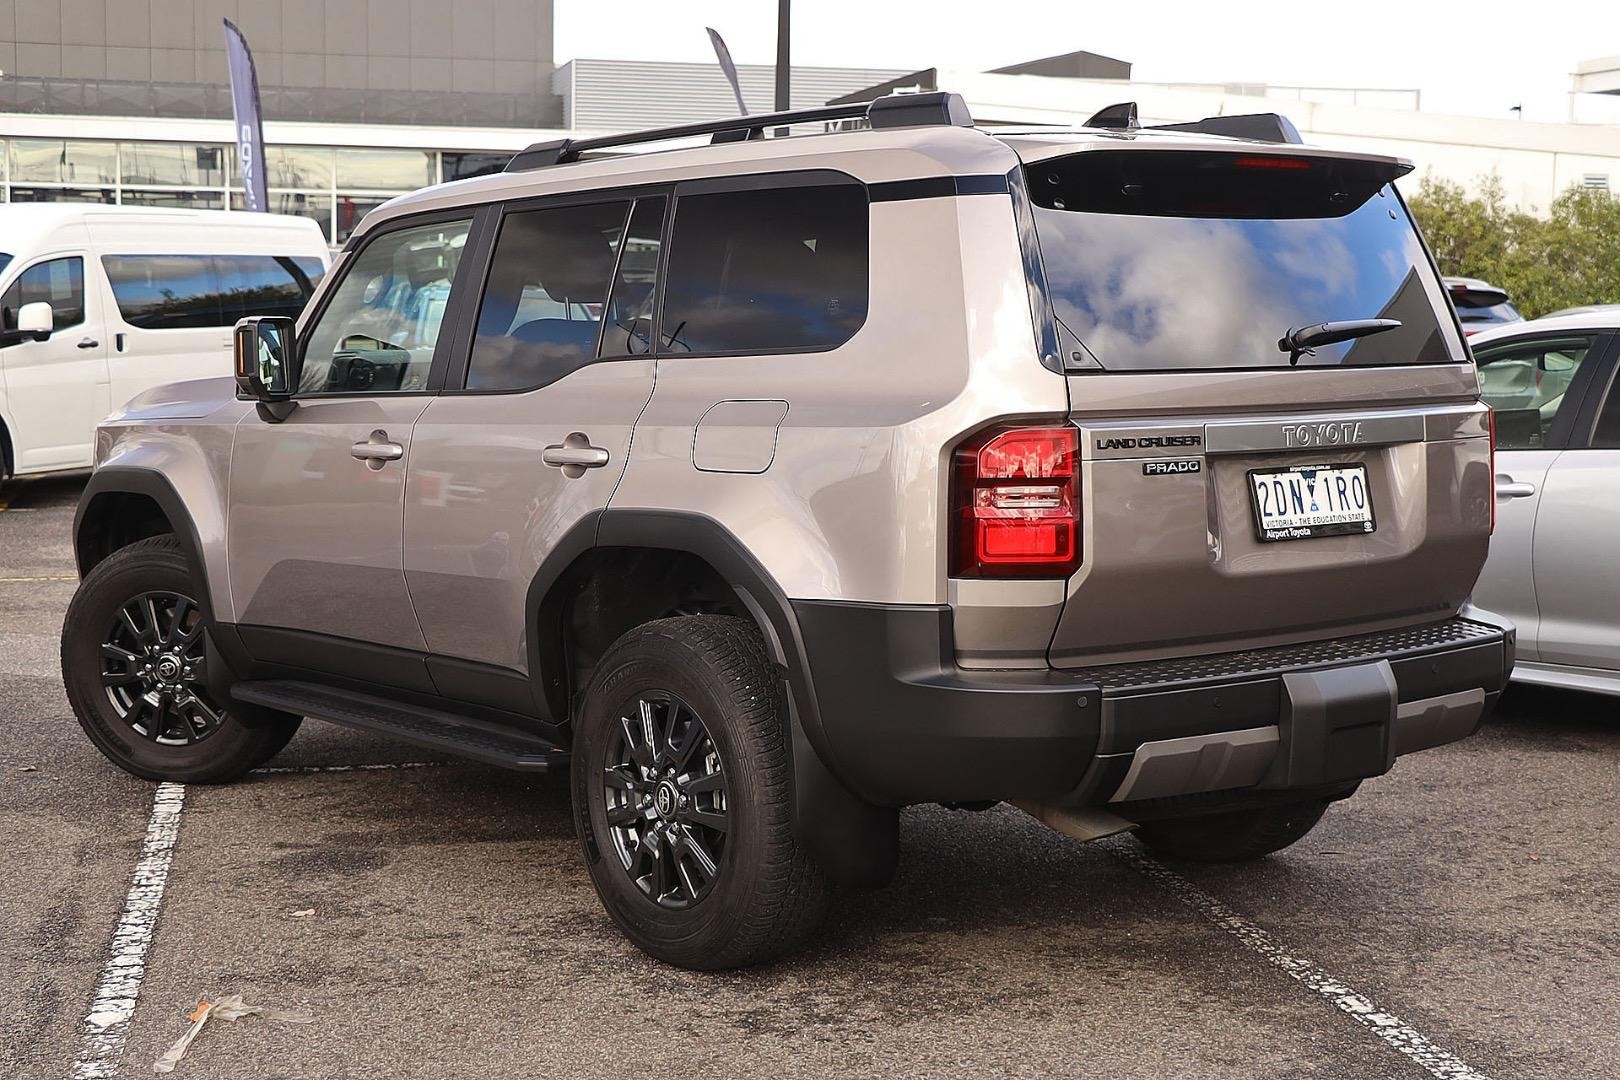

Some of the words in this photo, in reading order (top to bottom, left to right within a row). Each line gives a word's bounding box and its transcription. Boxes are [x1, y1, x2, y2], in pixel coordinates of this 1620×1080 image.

[1282, 422, 1367, 447] TOYOTA
[1096, 438, 1136, 449] LAND
[1137, 436, 1201, 448] CRUISER
[1146, 461, 1199, 474] PRADO
[1258, 479, 1304, 517] 2DN
[1265, 519, 1293, 528] VICTORIA
[1299, 517, 1311, 525] THE
[1313, 514, 1347, 524] EDUCATION
[1348, 512, 1365, 521] STATE
[1266, 529, 1290, 539] Airport
[1288, 527, 1311, 538] Toyota
